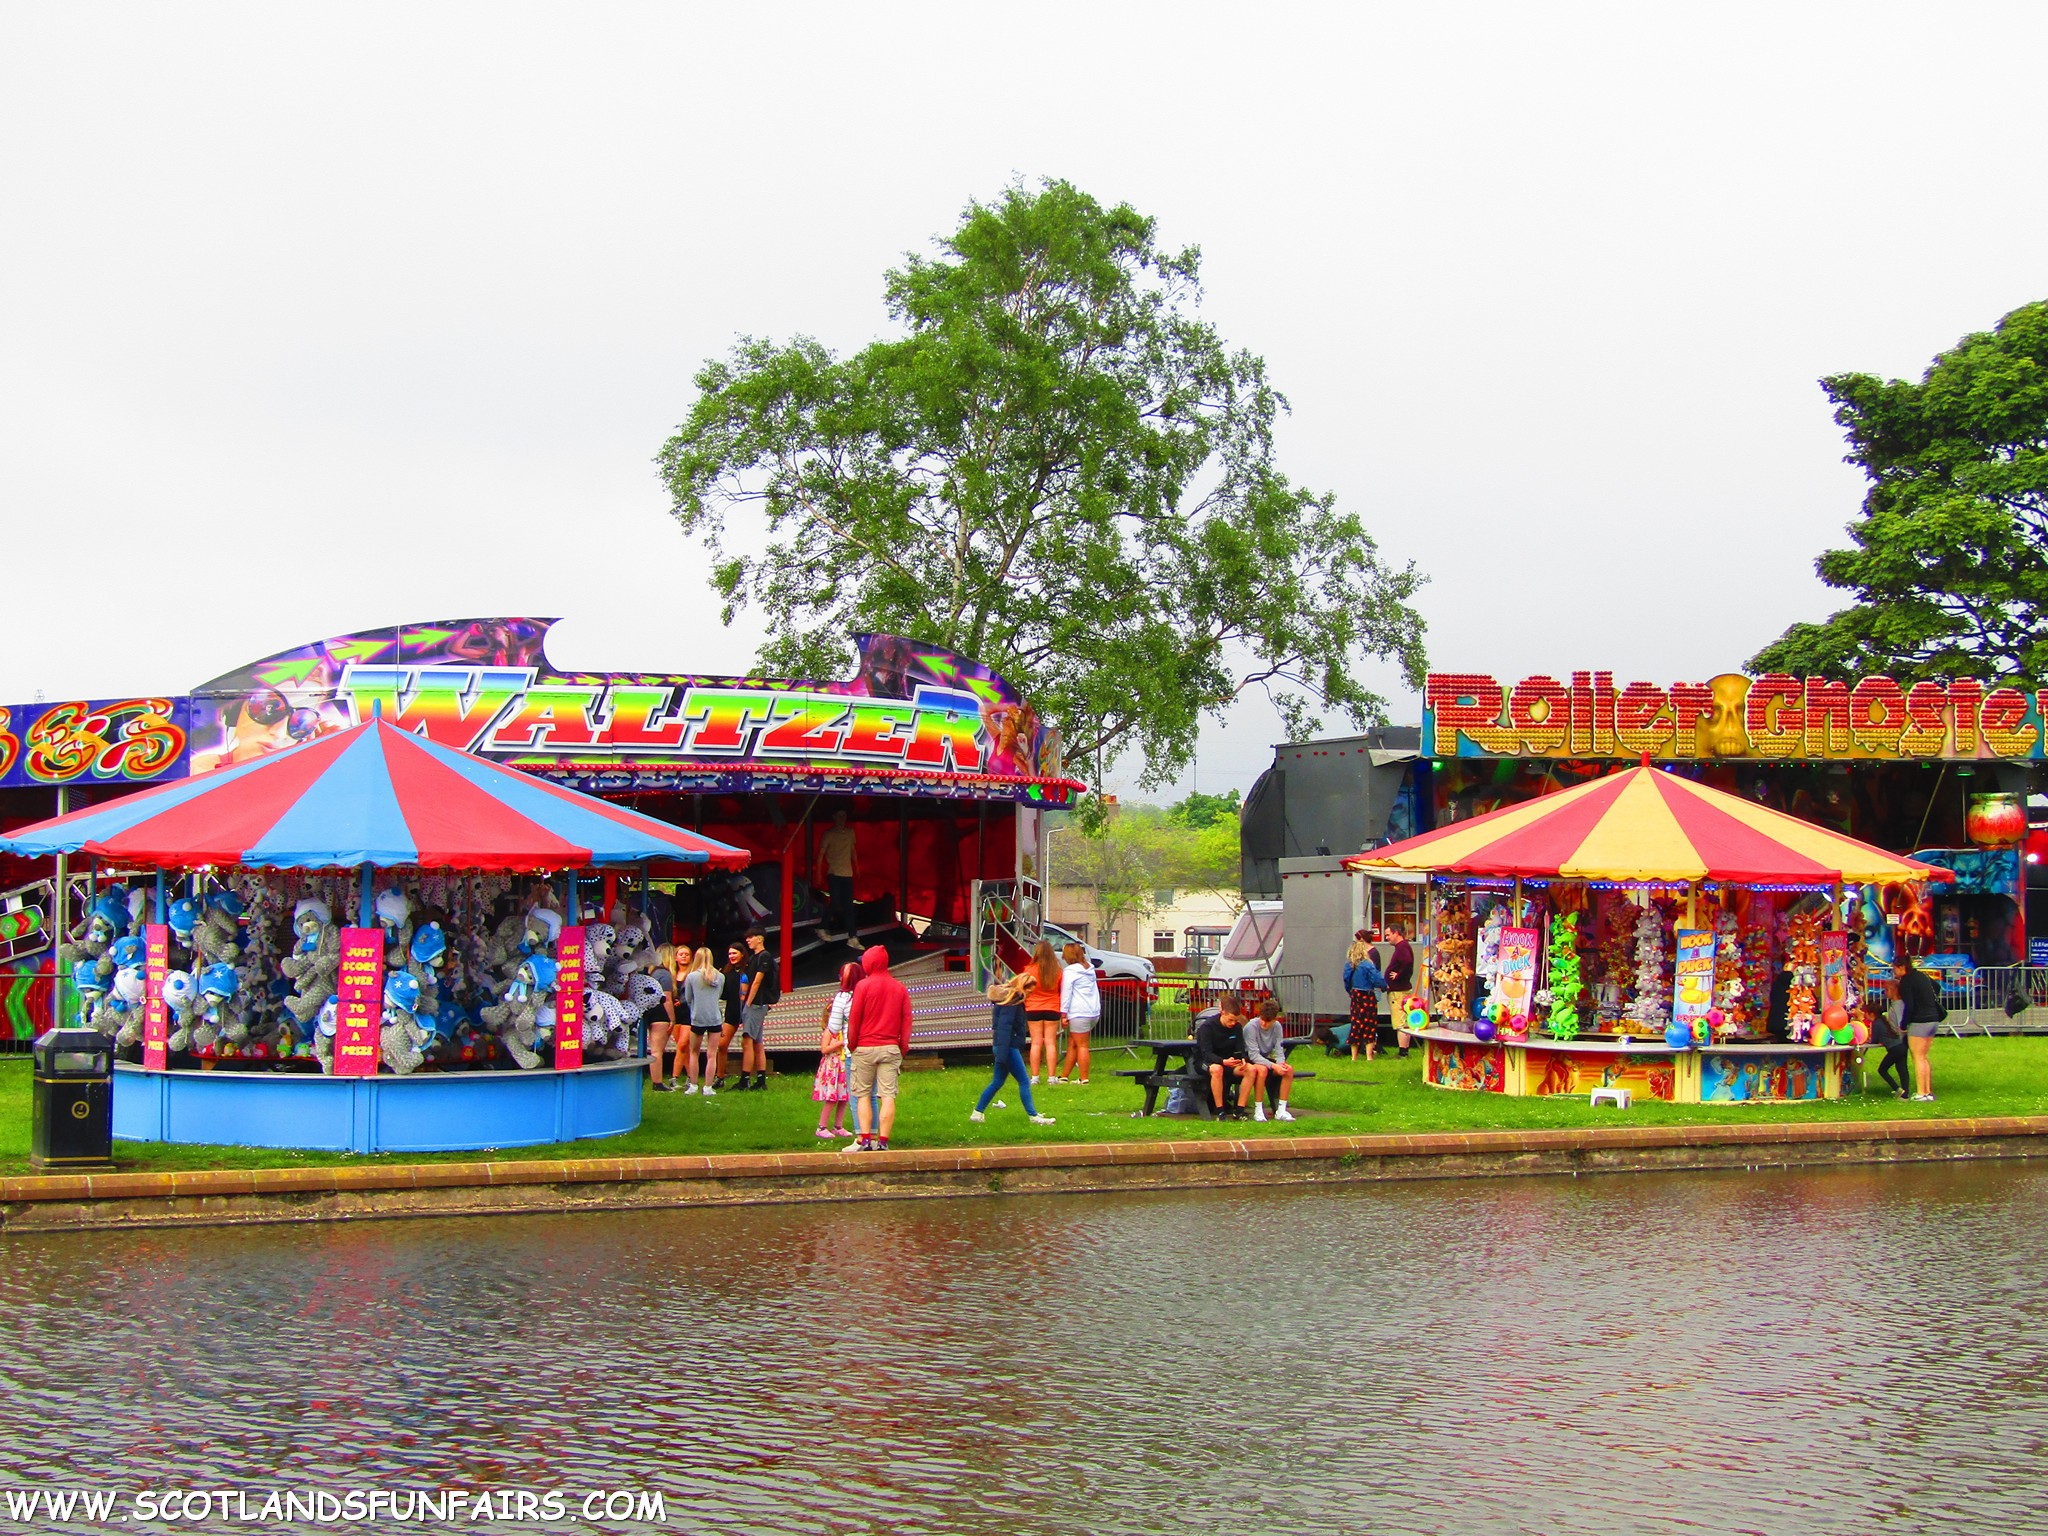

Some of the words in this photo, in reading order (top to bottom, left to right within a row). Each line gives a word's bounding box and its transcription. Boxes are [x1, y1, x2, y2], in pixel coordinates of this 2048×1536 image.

[336, 664, 987, 772] WALTZER
[1427, 671, 1714, 756] Roller
[1744, 673, 2048, 757] Ghoste
[752, 772, 1015, 798] PLEASURE
[1503, 930, 1534, 947] HOOK
[1680, 932, 1713, 950] HOOK
[346, 947, 375, 958] JUST
[561, 945, 579, 955] JUST
[1512, 950, 1520, 960] A
[342, 962, 377, 972] SCORE
[1678, 957, 1713, 975] DUCK
[344, 976, 373, 985] OVER
[560, 972, 579, 982] OVER
[349, 1004, 366, 1013] TO
[564, 999, 574, 1009] TO
[346, 1018, 368, 1027] WIN
[351, 1032, 360, 1041] A
[566, 1027, 572, 1036] A
[341, 1046, 373, 1056] PRIZE
